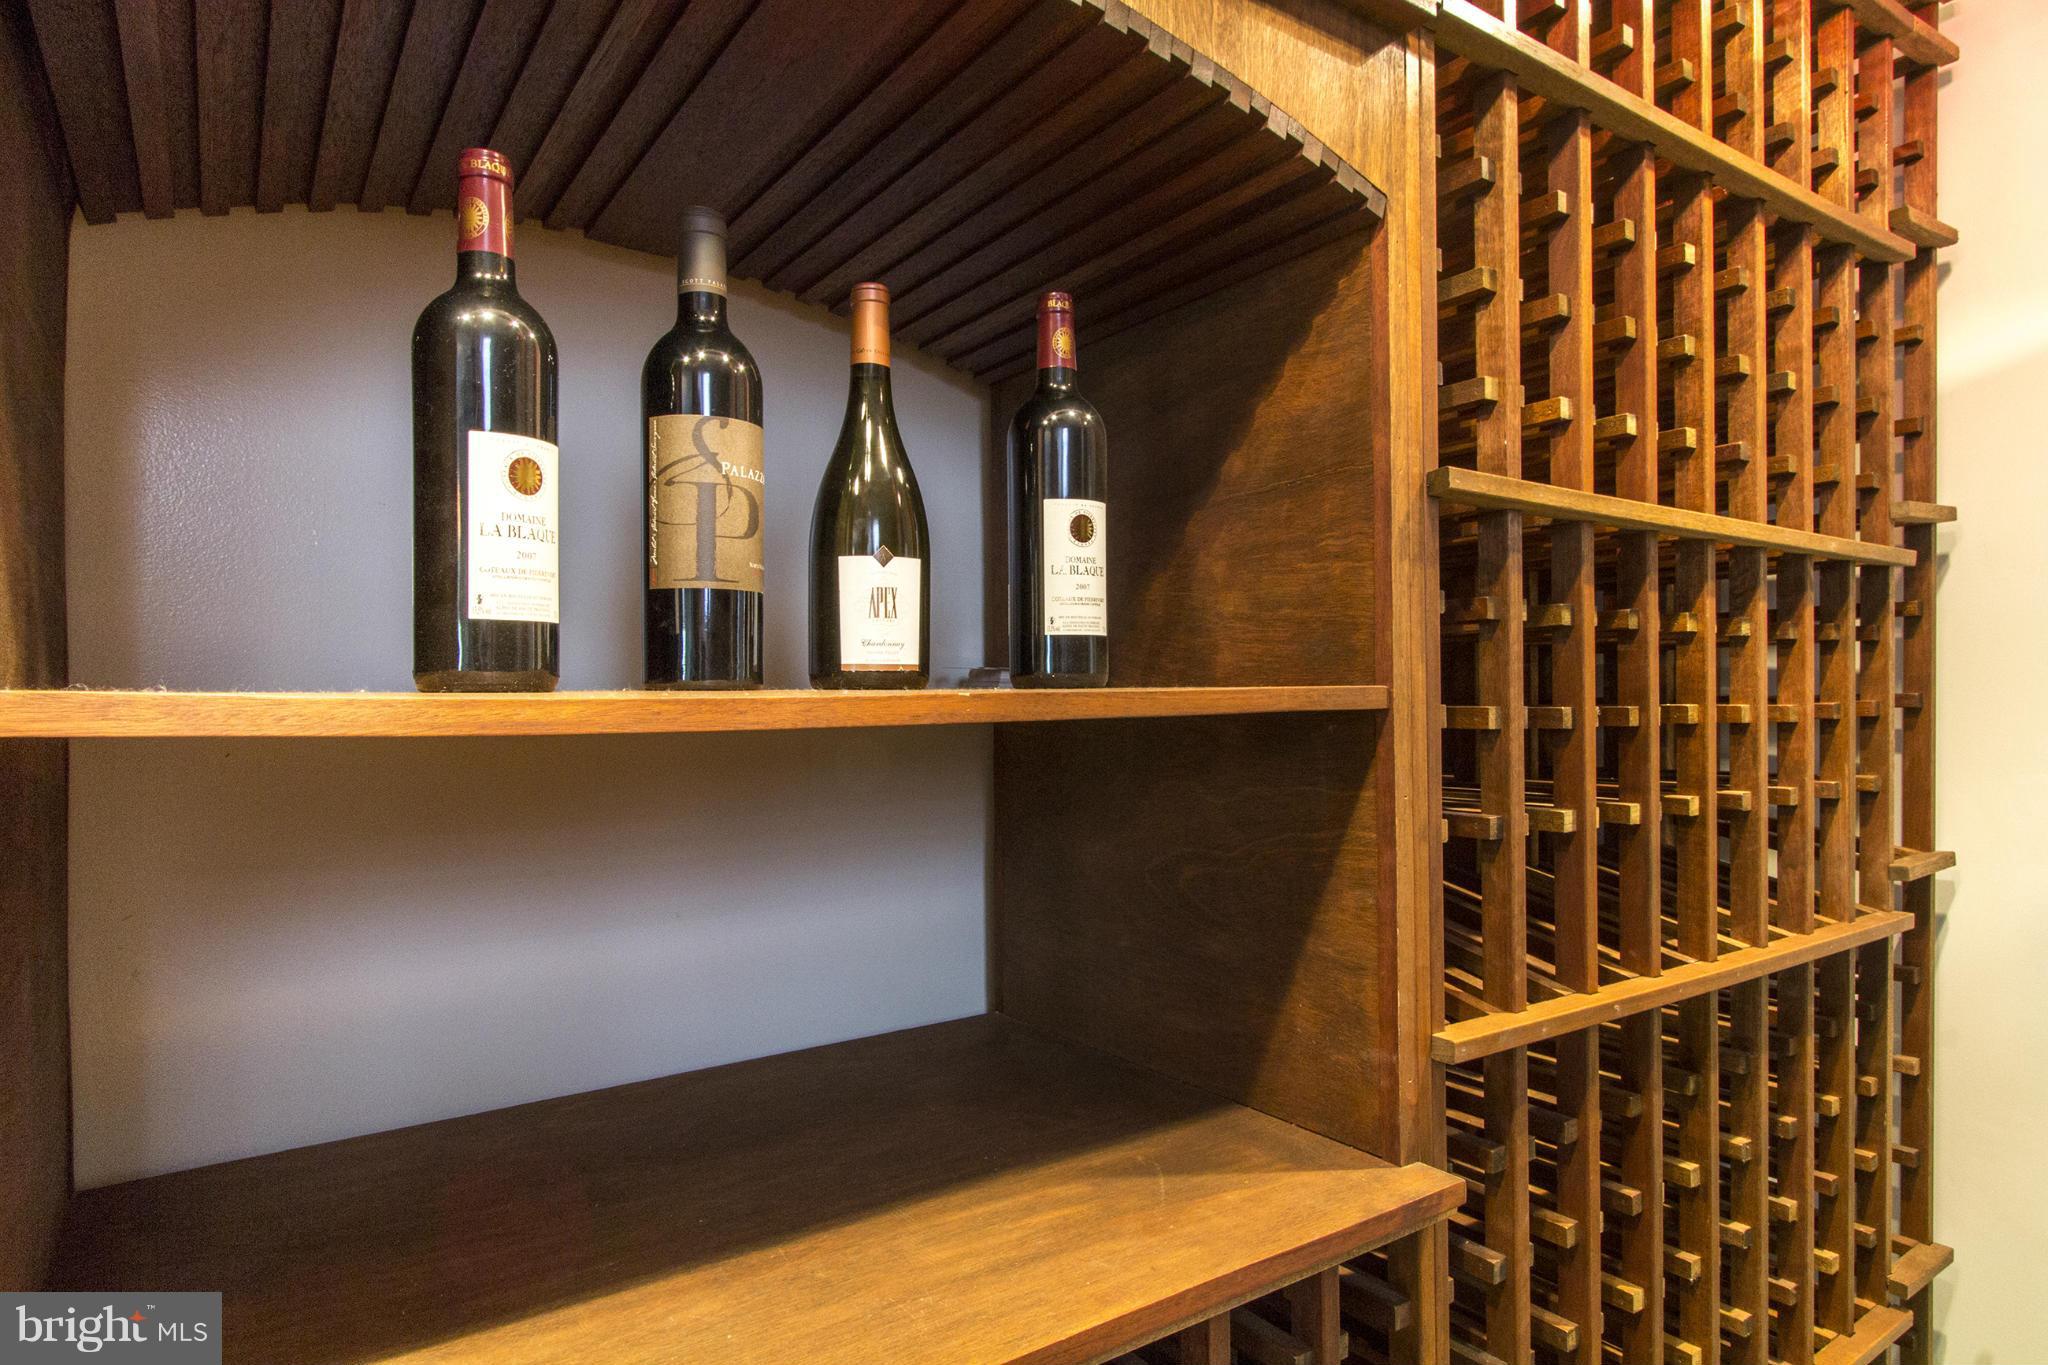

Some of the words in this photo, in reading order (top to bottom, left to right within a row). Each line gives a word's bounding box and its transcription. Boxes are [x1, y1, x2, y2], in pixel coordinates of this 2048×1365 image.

[501, 511, 547, 527] DOMAINE
[479, 521, 502, 537] LA
[507, 524, 556, 545] BLAQUE
[515, 550, 537, 560] 2007
[1065, 555, 1097, 565] DOMAINE
[1069, 565, 1105, 577] BLAQUE
[868, 586, 898, 619] APEX
[860, 638, 905, 650] Chardonnay
